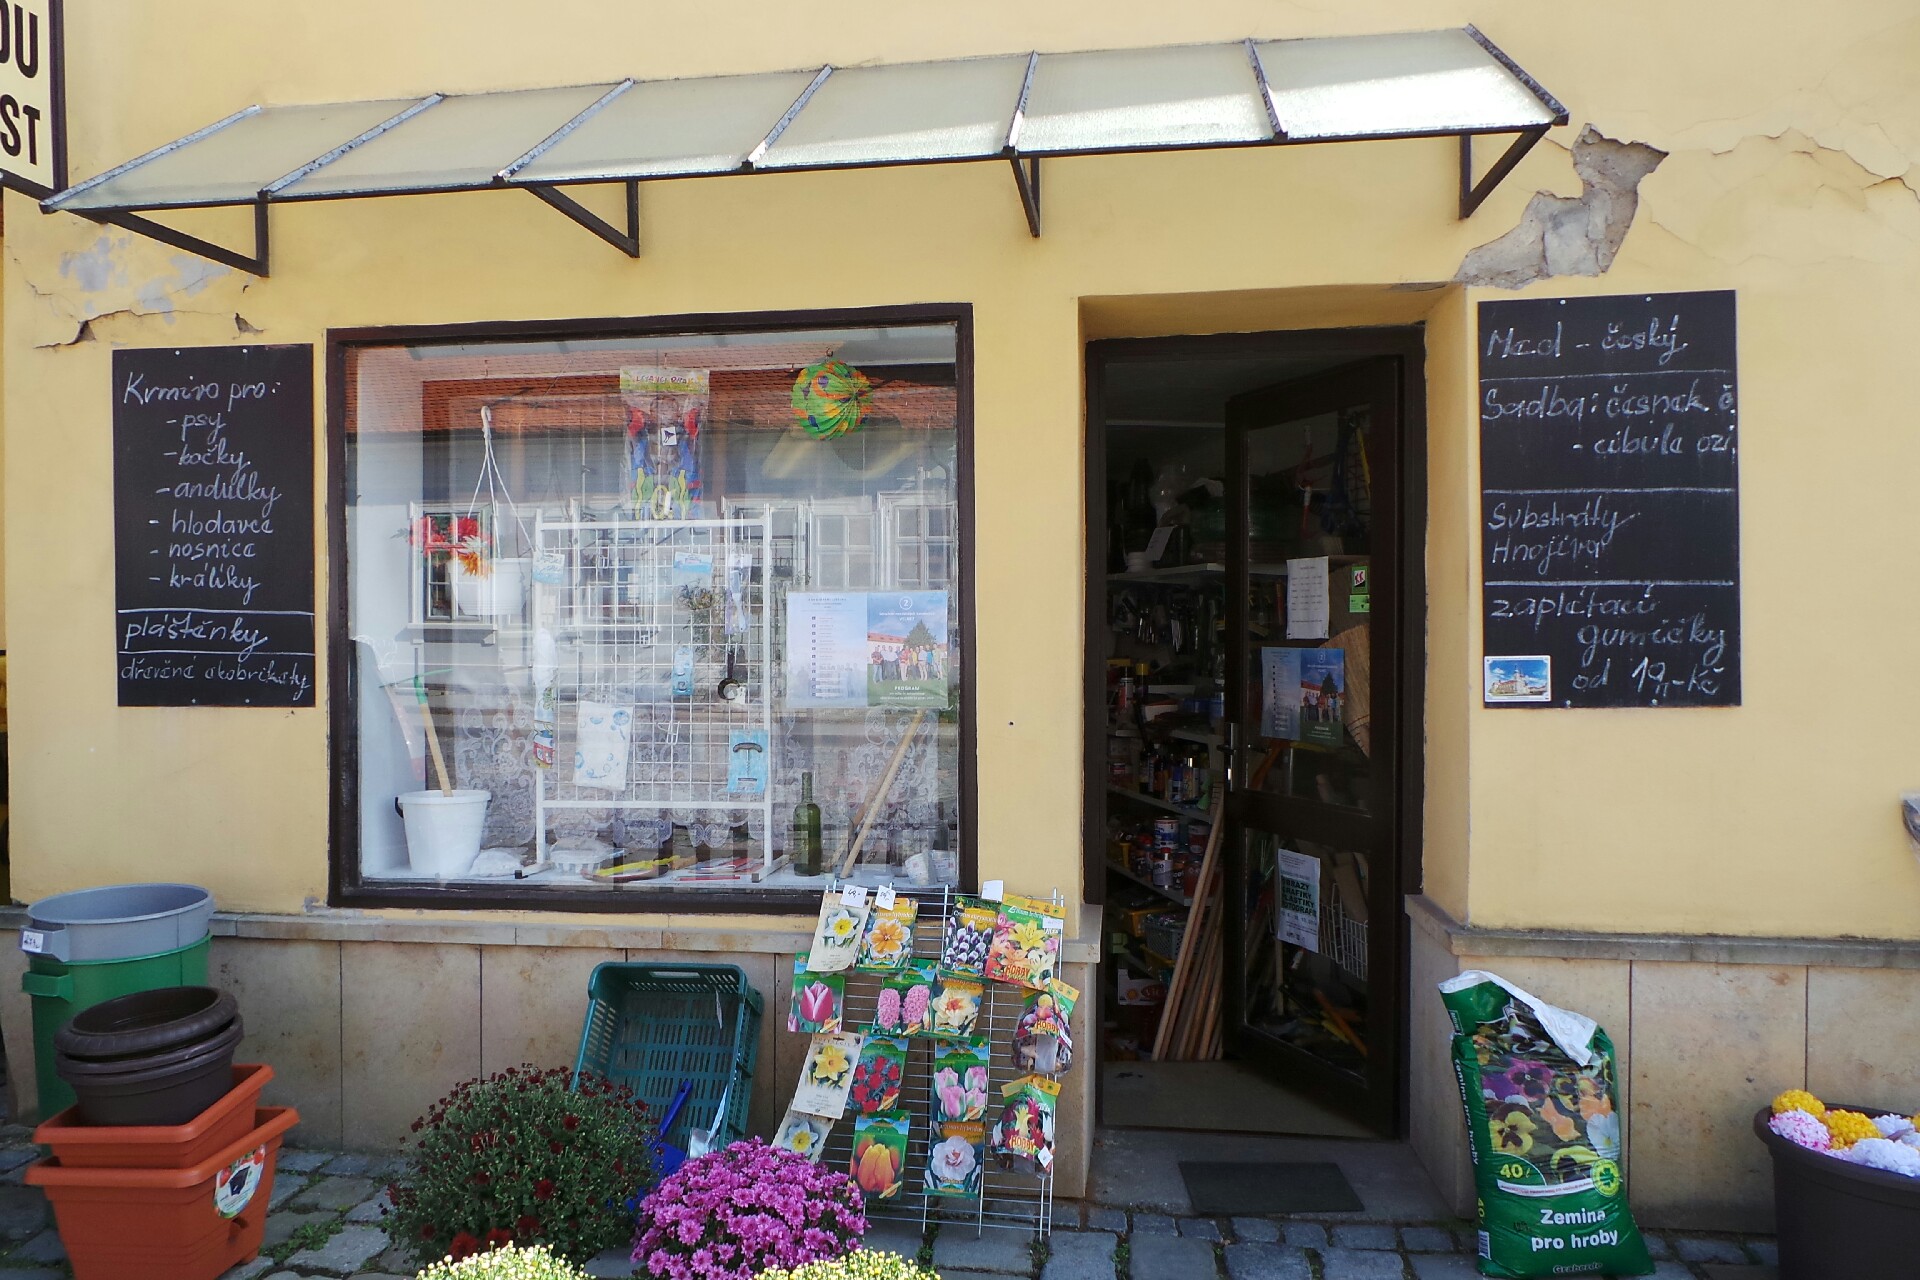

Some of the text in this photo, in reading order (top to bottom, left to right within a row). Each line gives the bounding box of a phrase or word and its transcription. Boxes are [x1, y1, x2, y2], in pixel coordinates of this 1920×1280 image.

[1487, 321, 1562, 358] Med
[124, 372, 281, 411] Krmivo pro:
[1594, 423, 1684, 455] cibule
[172, 509, 274, 535] hlodavce
[169, 538, 257, 561] nosnice
[1492, 535, 1606, 575] Hnojiva
[169, 562, 261, 605] králíky
[124, 612, 268, 662] pláštěnky
[1573, 658, 1610, 689] od
[1500, 1164, 1523, 1179] 40
[1540, 1208, 1606, 1224] Zemina
[1532, 1229, 1618, 1251] pro hroby
